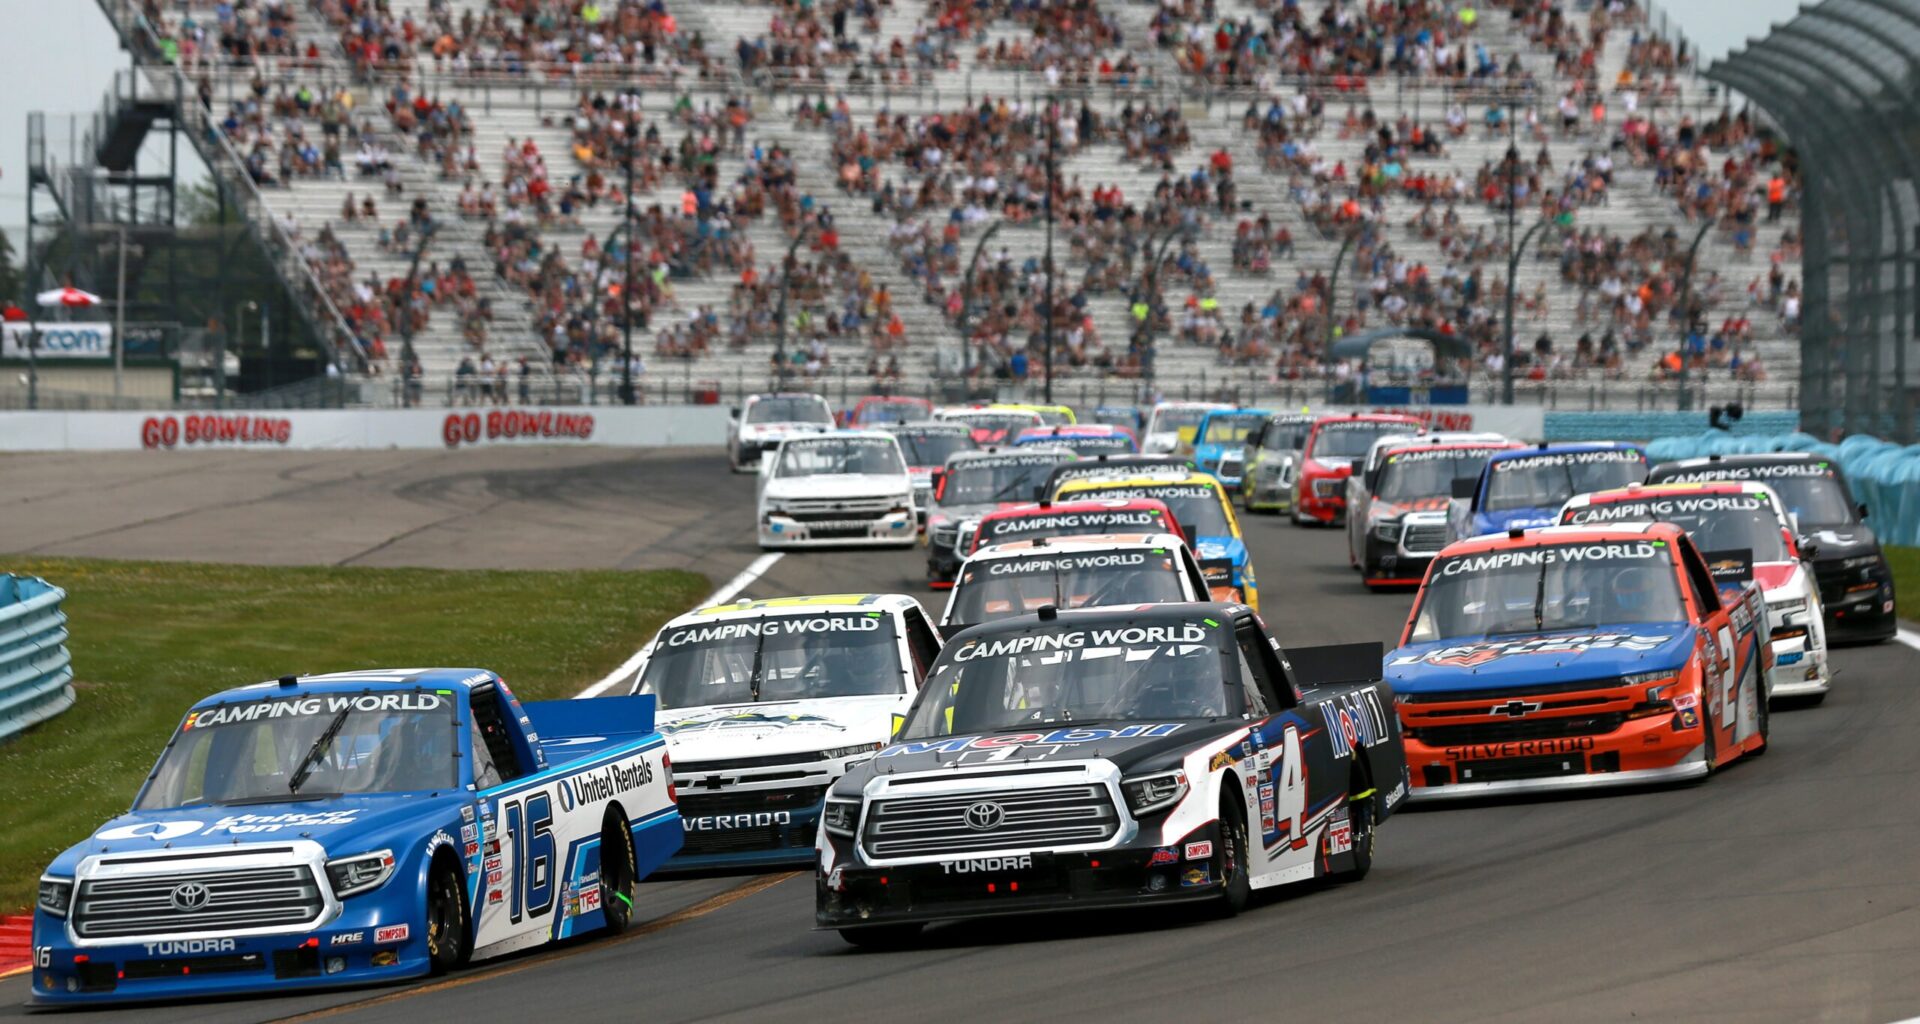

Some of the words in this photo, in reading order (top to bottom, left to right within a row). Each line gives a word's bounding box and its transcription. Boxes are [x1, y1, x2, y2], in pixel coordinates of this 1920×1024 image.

[141, 417, 179, 448] GO
[184, 414, 291, 444] BOWLING
[442, 413, 480, 446] GO
[486, 411, 594, 439] BOWLING
[955, 458, 1018, 471] CAMPING
[1394, 449, 1466, 462] CAMPING
[1497, 453, 1575, 472] CAMPING
[1577, 450, 1640, 464] WORLD
[1062, 465, 1131, 481] CAMPING
[1133, 464, 1189, 475] WORLD
[1662, 467, 1750, 485] CAMPING
[1752, 464, 1824, 479] WORLD
[1069, 487, 1147, 501] CAMPING
[1148, 487, 1212, 499] WORLD
[1572, 501, 1673, 525] CAMPING
[1676, 497, 1762, 513] WORLD
[994, 515, 1080, 534] CAMPING
[1081, 513, 1153, 525] WORLD
[989, 559, 1073, 575] CAMPING
[1076, 554, 1145, 569] WORLD
[1444, 549, 1556, 576] CAMPING
[1559, 544, 1656, 563] WORLD
[668, 621, 779, 647] CAMPING
[785, 616, 880, 635] WORLD
[954, 630, 1086, 663] CAMPING
[1090, 626, 1207, 646] WORLD
[1718, 623, 1737, 730] 2
[193, 698, 321, 729] CAMPING
[327, 693, 441, 713] WORLD
[1318, 691, 1376, 759] Mobil
[878, 723, 1187, 758] Mobil
[1445, 736, 1595, 761] SILVERADO
[573, 766, 615, 807] United
[611, 755, 654, 794] Rentals
[1278, 722, 1308, 848] 4
[682, 811, 791, 832] VERADO
[505, 789, 557, 926] 16
[1187, 843, 1211, 858] SIMPSON
[940, 855, 1033, 874] TUNDRA
[827, 867, 843, 891] 4
[330, 931, 364, 945] HRE
[377, 927, 407, 941] SIMPSON
[34, 945, 52, 969] 16
[143, 938, 236, 955] TUNDRA
